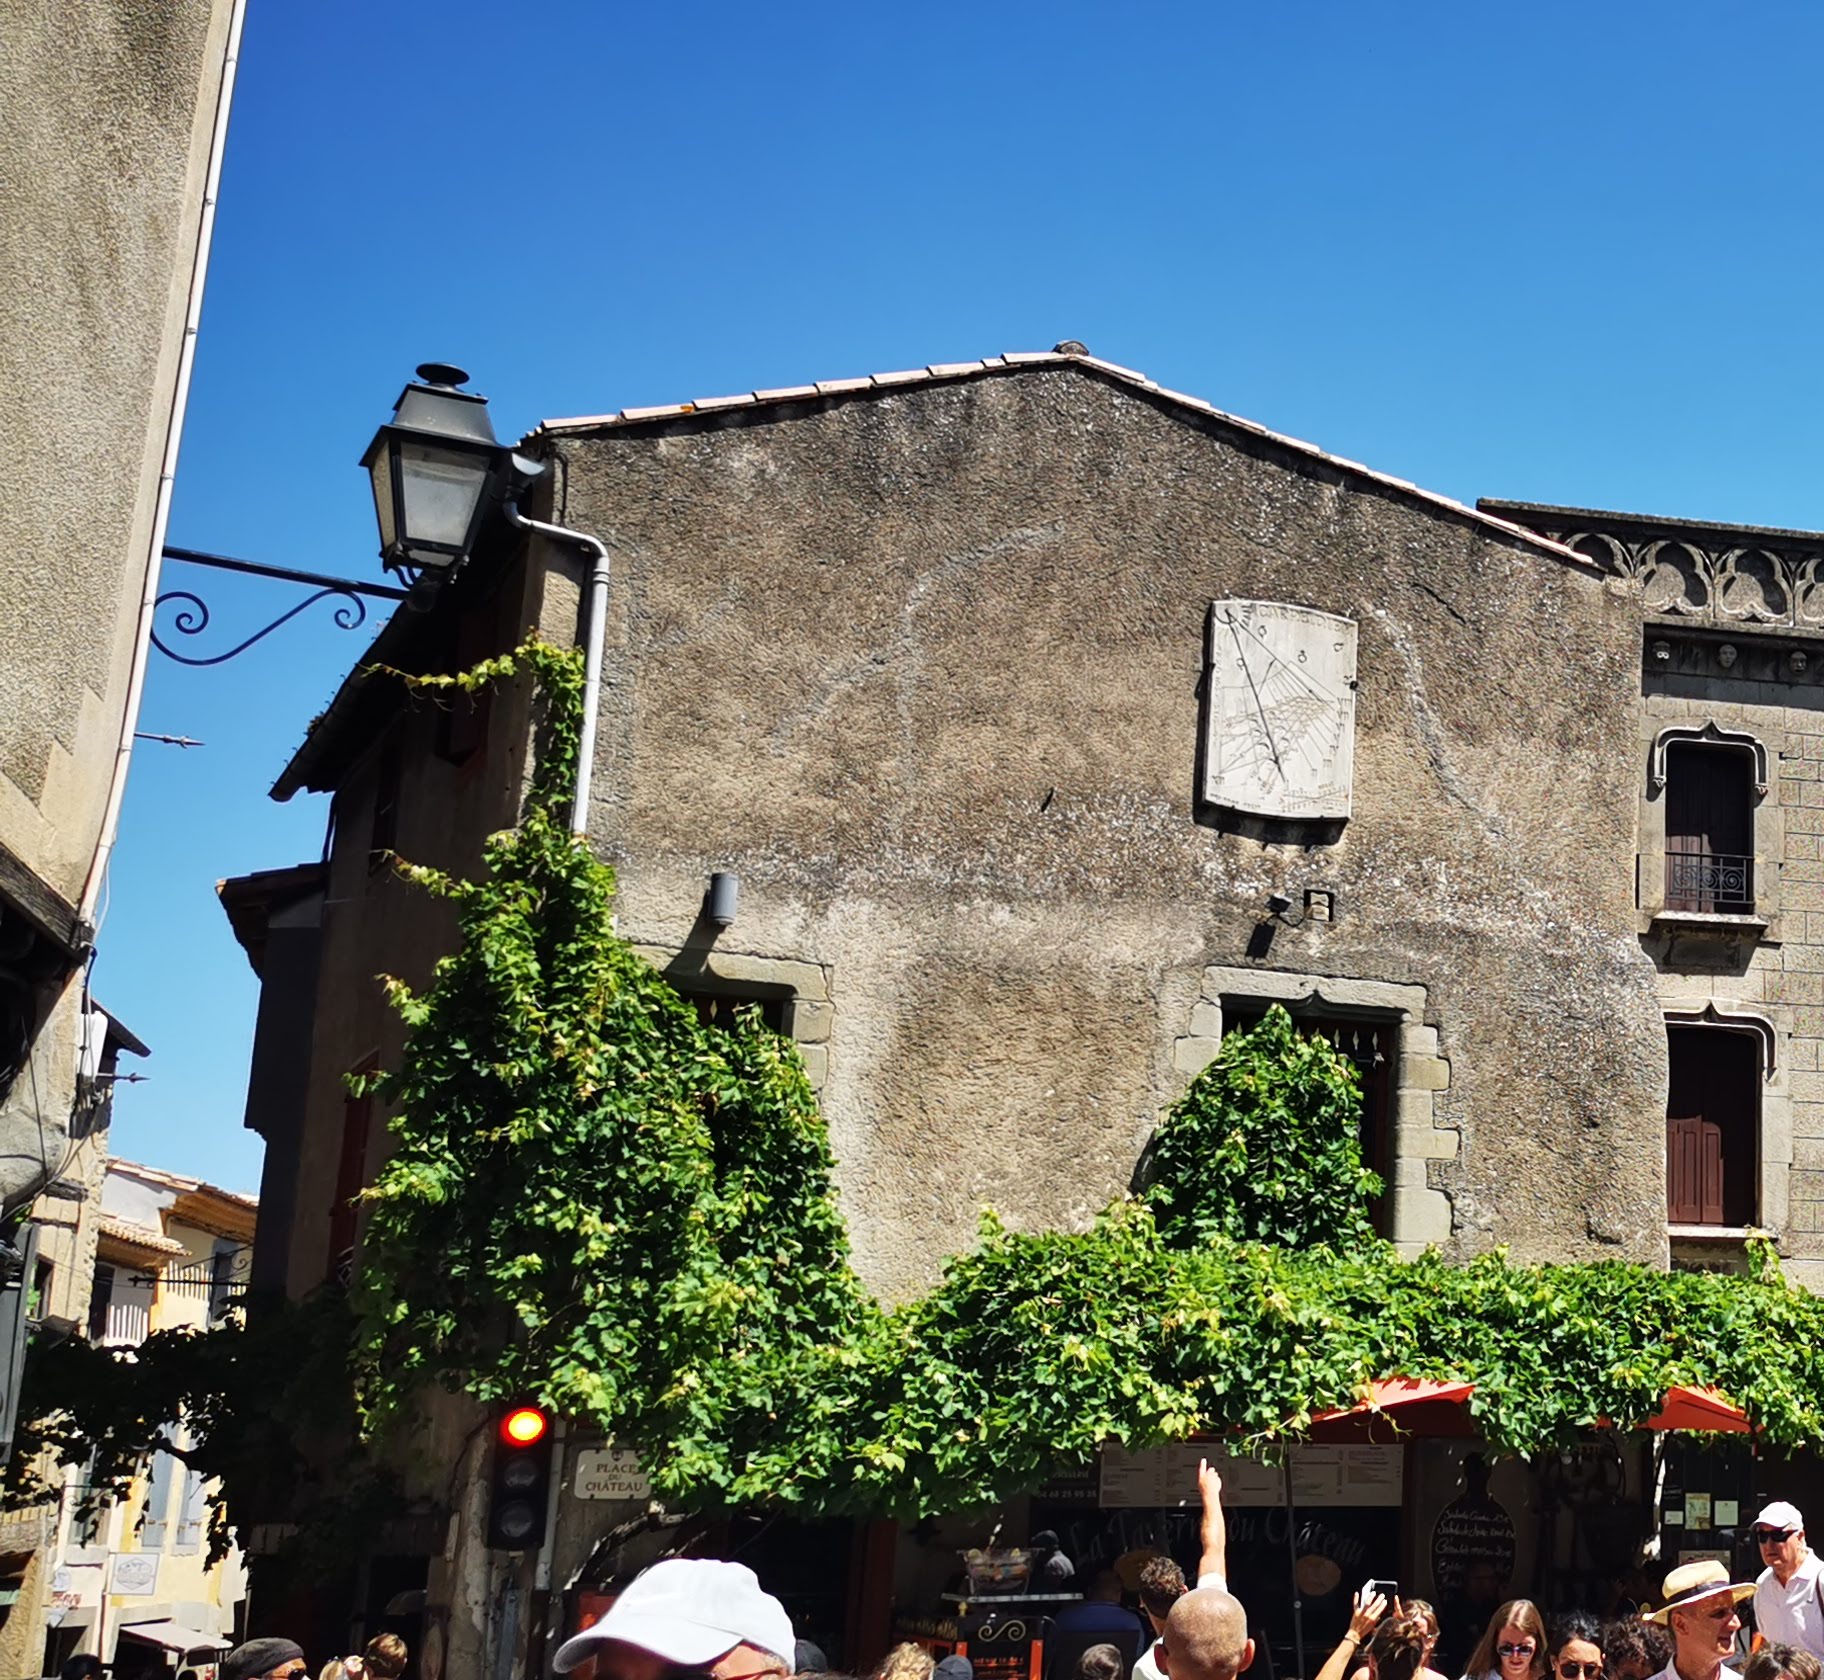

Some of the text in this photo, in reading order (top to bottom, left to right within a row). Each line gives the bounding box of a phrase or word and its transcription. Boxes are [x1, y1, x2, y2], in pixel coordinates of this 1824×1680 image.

[597, 1464, 637, 1473] PLACE
[608, 1473, 622, 1481] DU
[586, 1481, 643, 1492] CHÂTEAU
